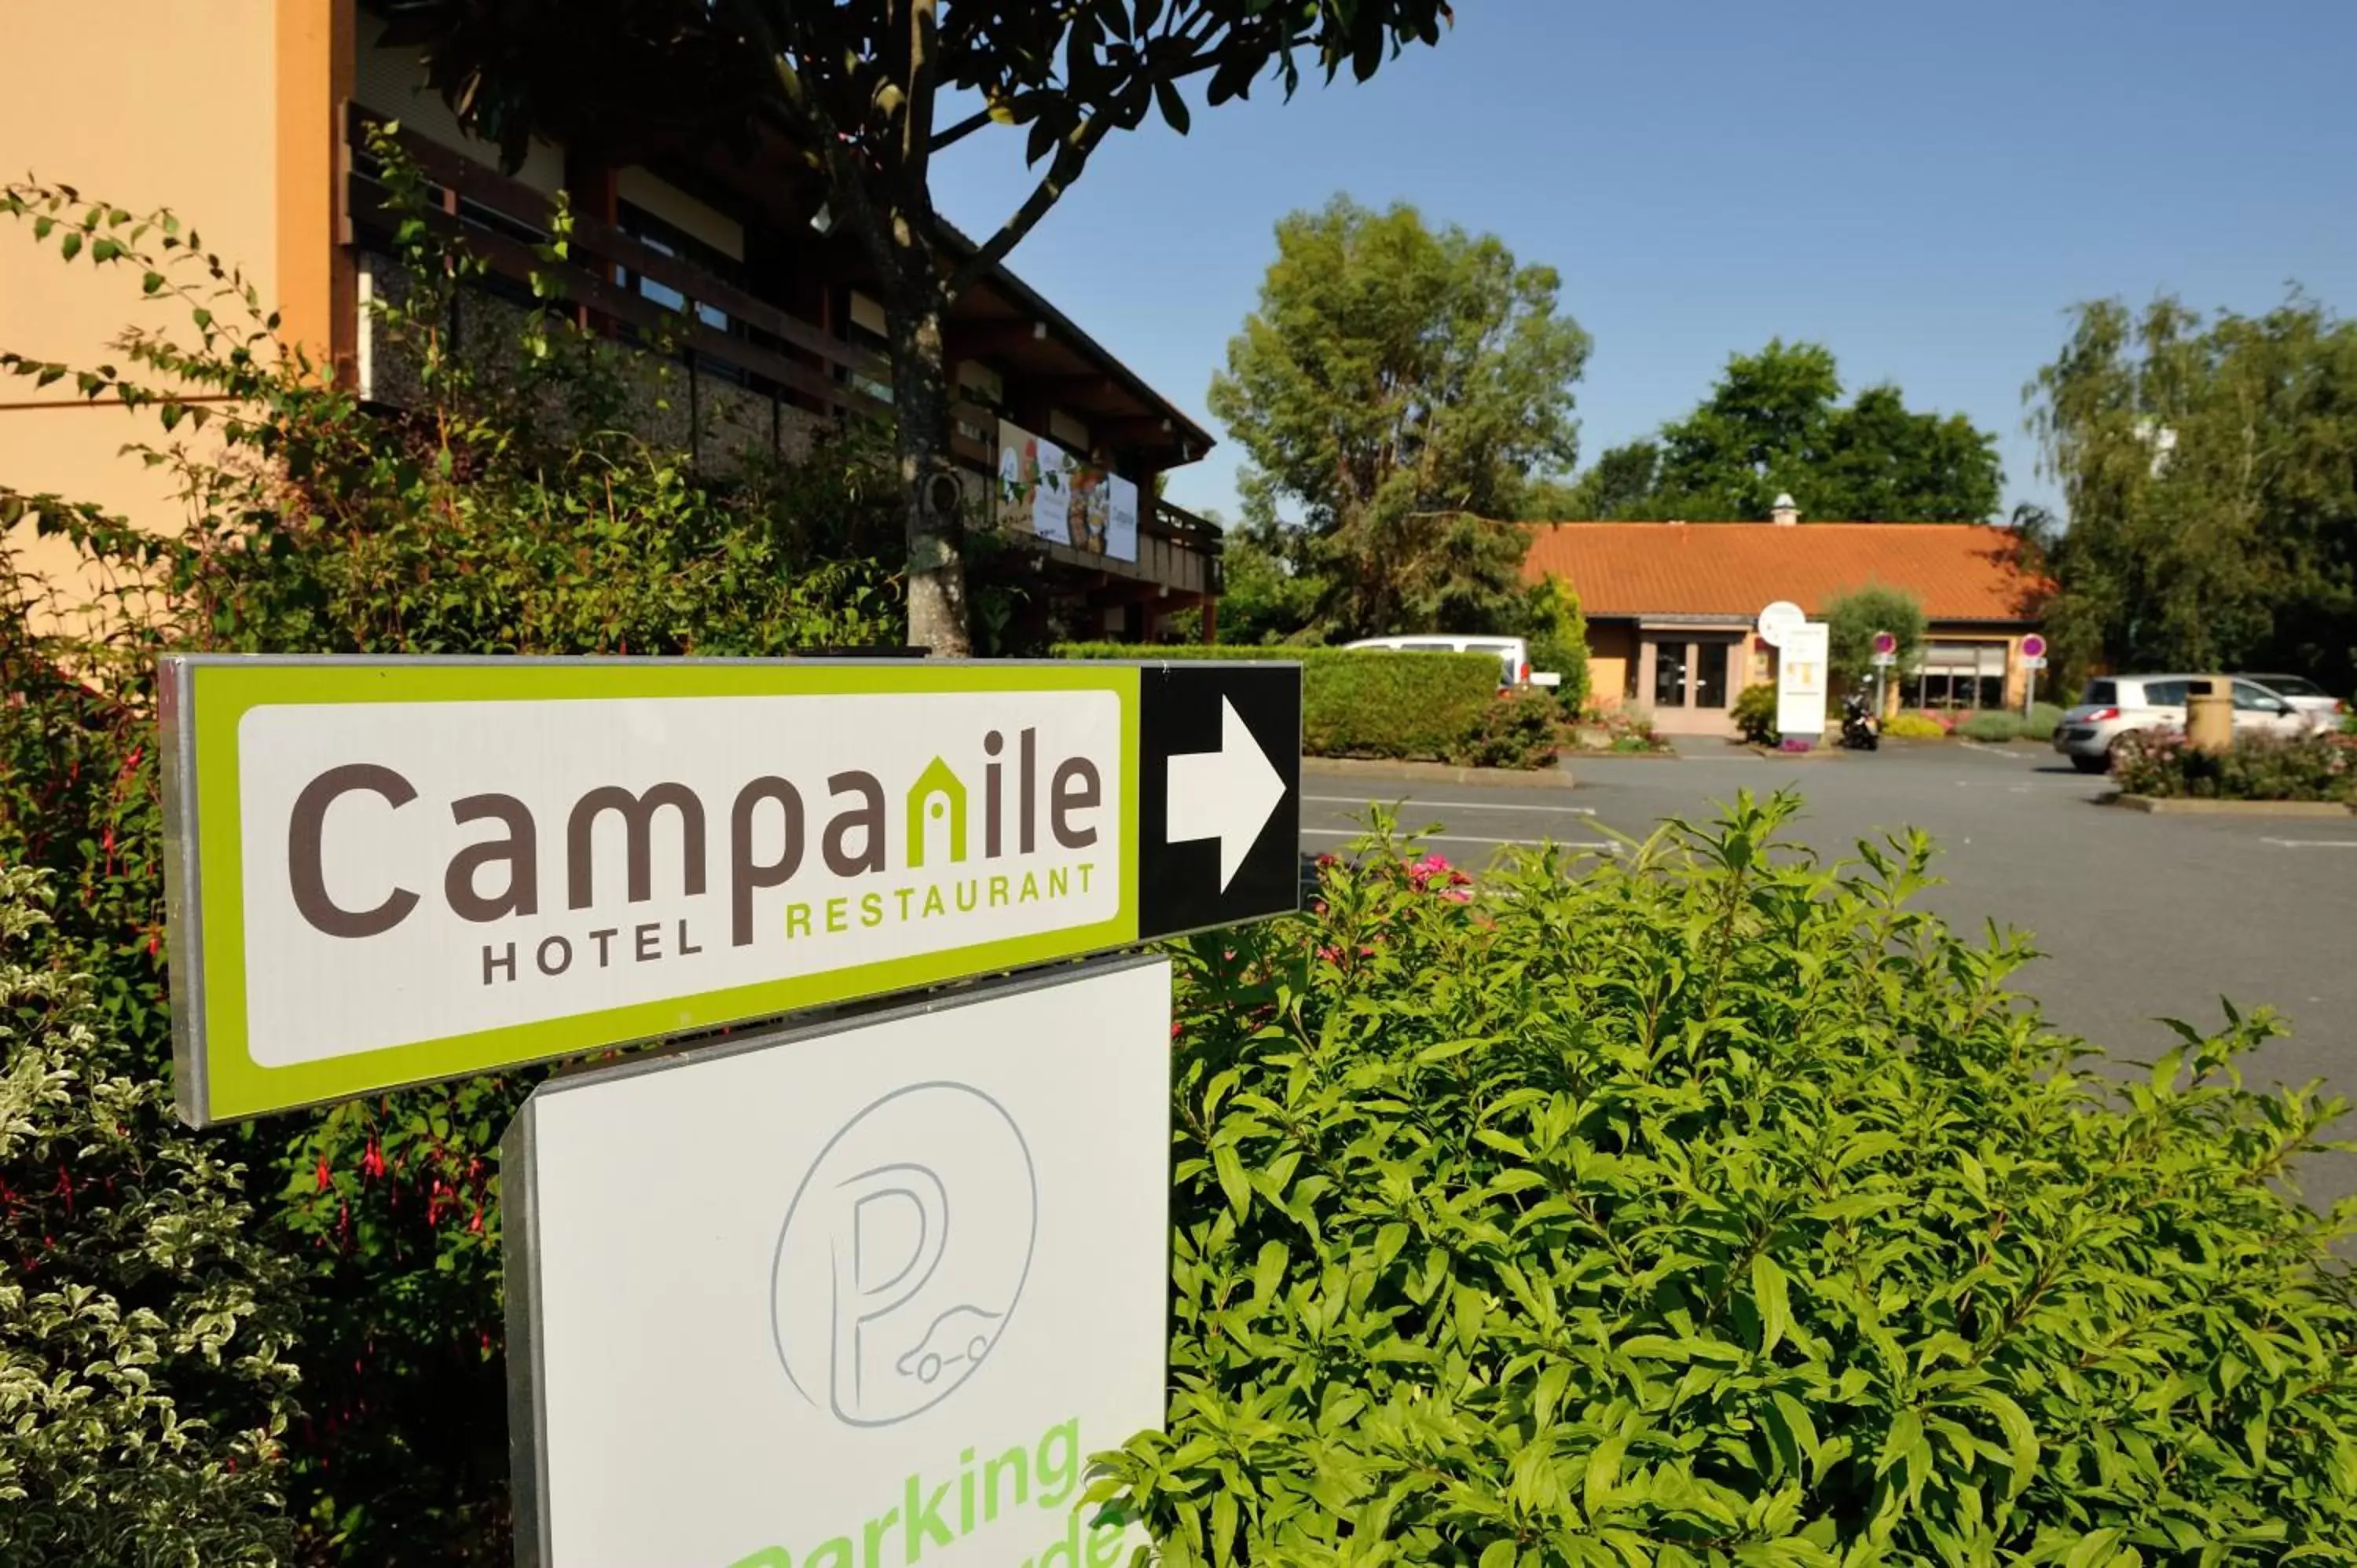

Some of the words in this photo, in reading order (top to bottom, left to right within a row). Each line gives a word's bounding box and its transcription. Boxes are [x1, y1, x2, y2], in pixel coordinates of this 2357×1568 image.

[288, 726, 1102, 947] Campanile
[786, 863, 1094, 939] RESTAURANT
[482, 919, 703, 986] HOTEL
